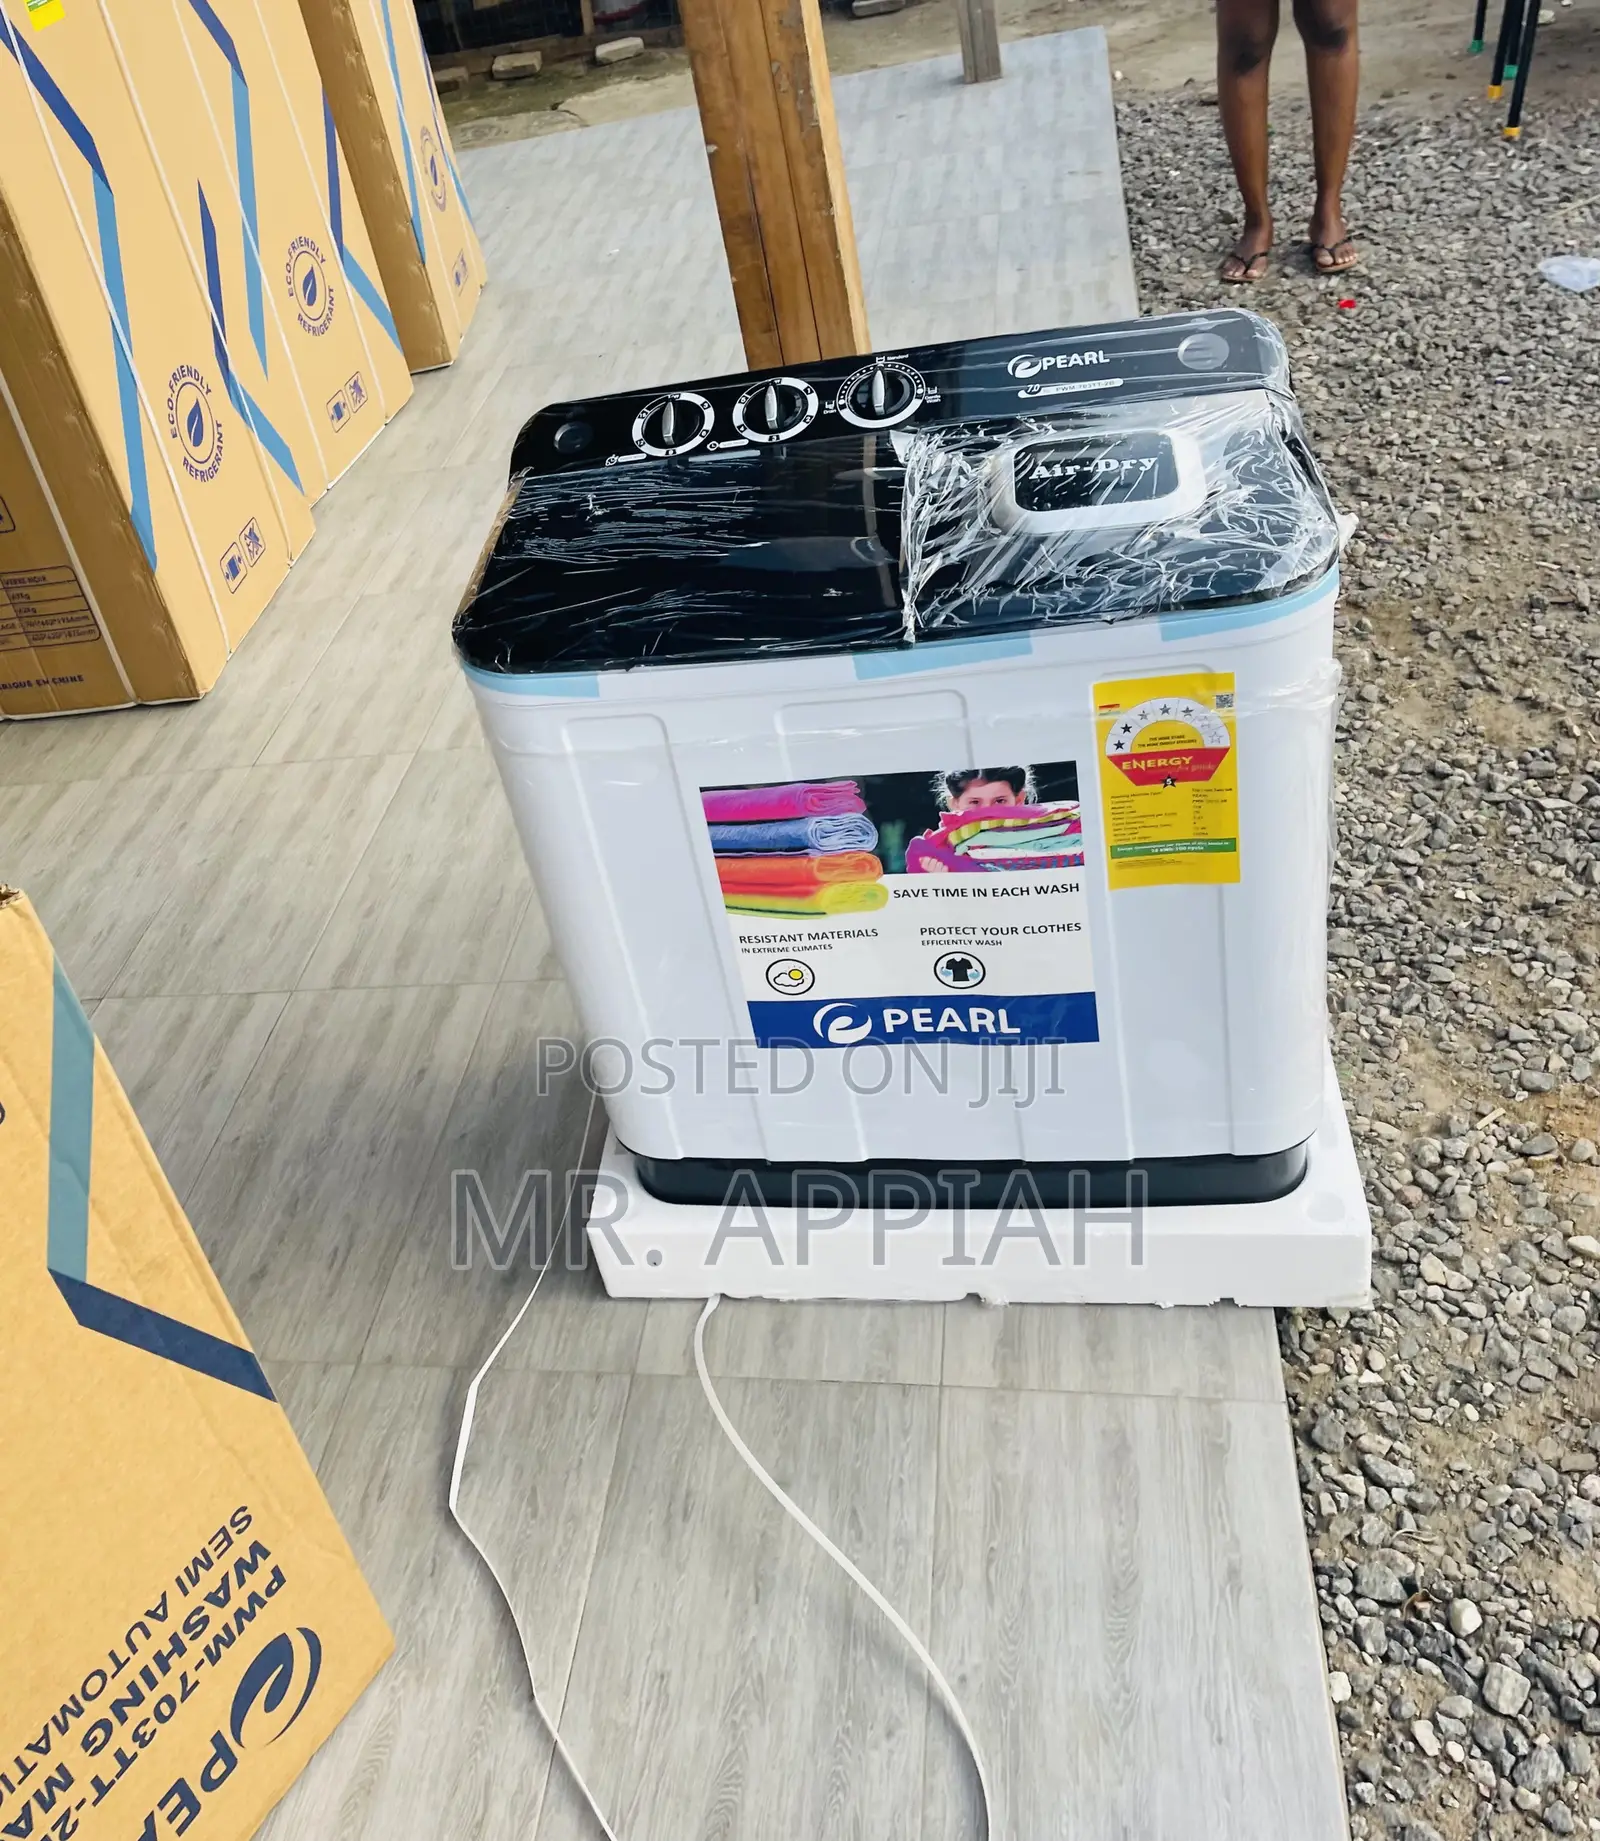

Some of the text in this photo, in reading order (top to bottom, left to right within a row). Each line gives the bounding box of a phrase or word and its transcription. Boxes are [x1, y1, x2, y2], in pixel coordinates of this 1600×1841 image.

[285, 236, 326, 297] ECO-FRIENDLY
[298, 285, 334, 337] REFRIGERANT
[1042, 350, 1110, 370] PEARL
[167, 364, 212, 438] ECO-FRIENDLY
[182, 420, 224, 482] REFRIGERANT
[1029, 457, 1158, 480] Air-Dry
[52, 674, 84, 685] CHINE
[1122, 756, 1194, 771] ENERGY
[893, 883, 1080, 898] SAVE TIME IN EACH WASH
[739, 928, 878, 944] RESISTANT MATERIALS
[920, 922, 1082, 936] PROTECT YOUR CLOTHES
[792, 944, 833, 952] CLIMATES
[883, 1006, 1021, 1034] PEARL
[174, 1505, 252, 1598] SEMI
[0, 1540, 272, 1841] WASHING MA
[40, 1564, 286, 1841] PWM-703TT-2
